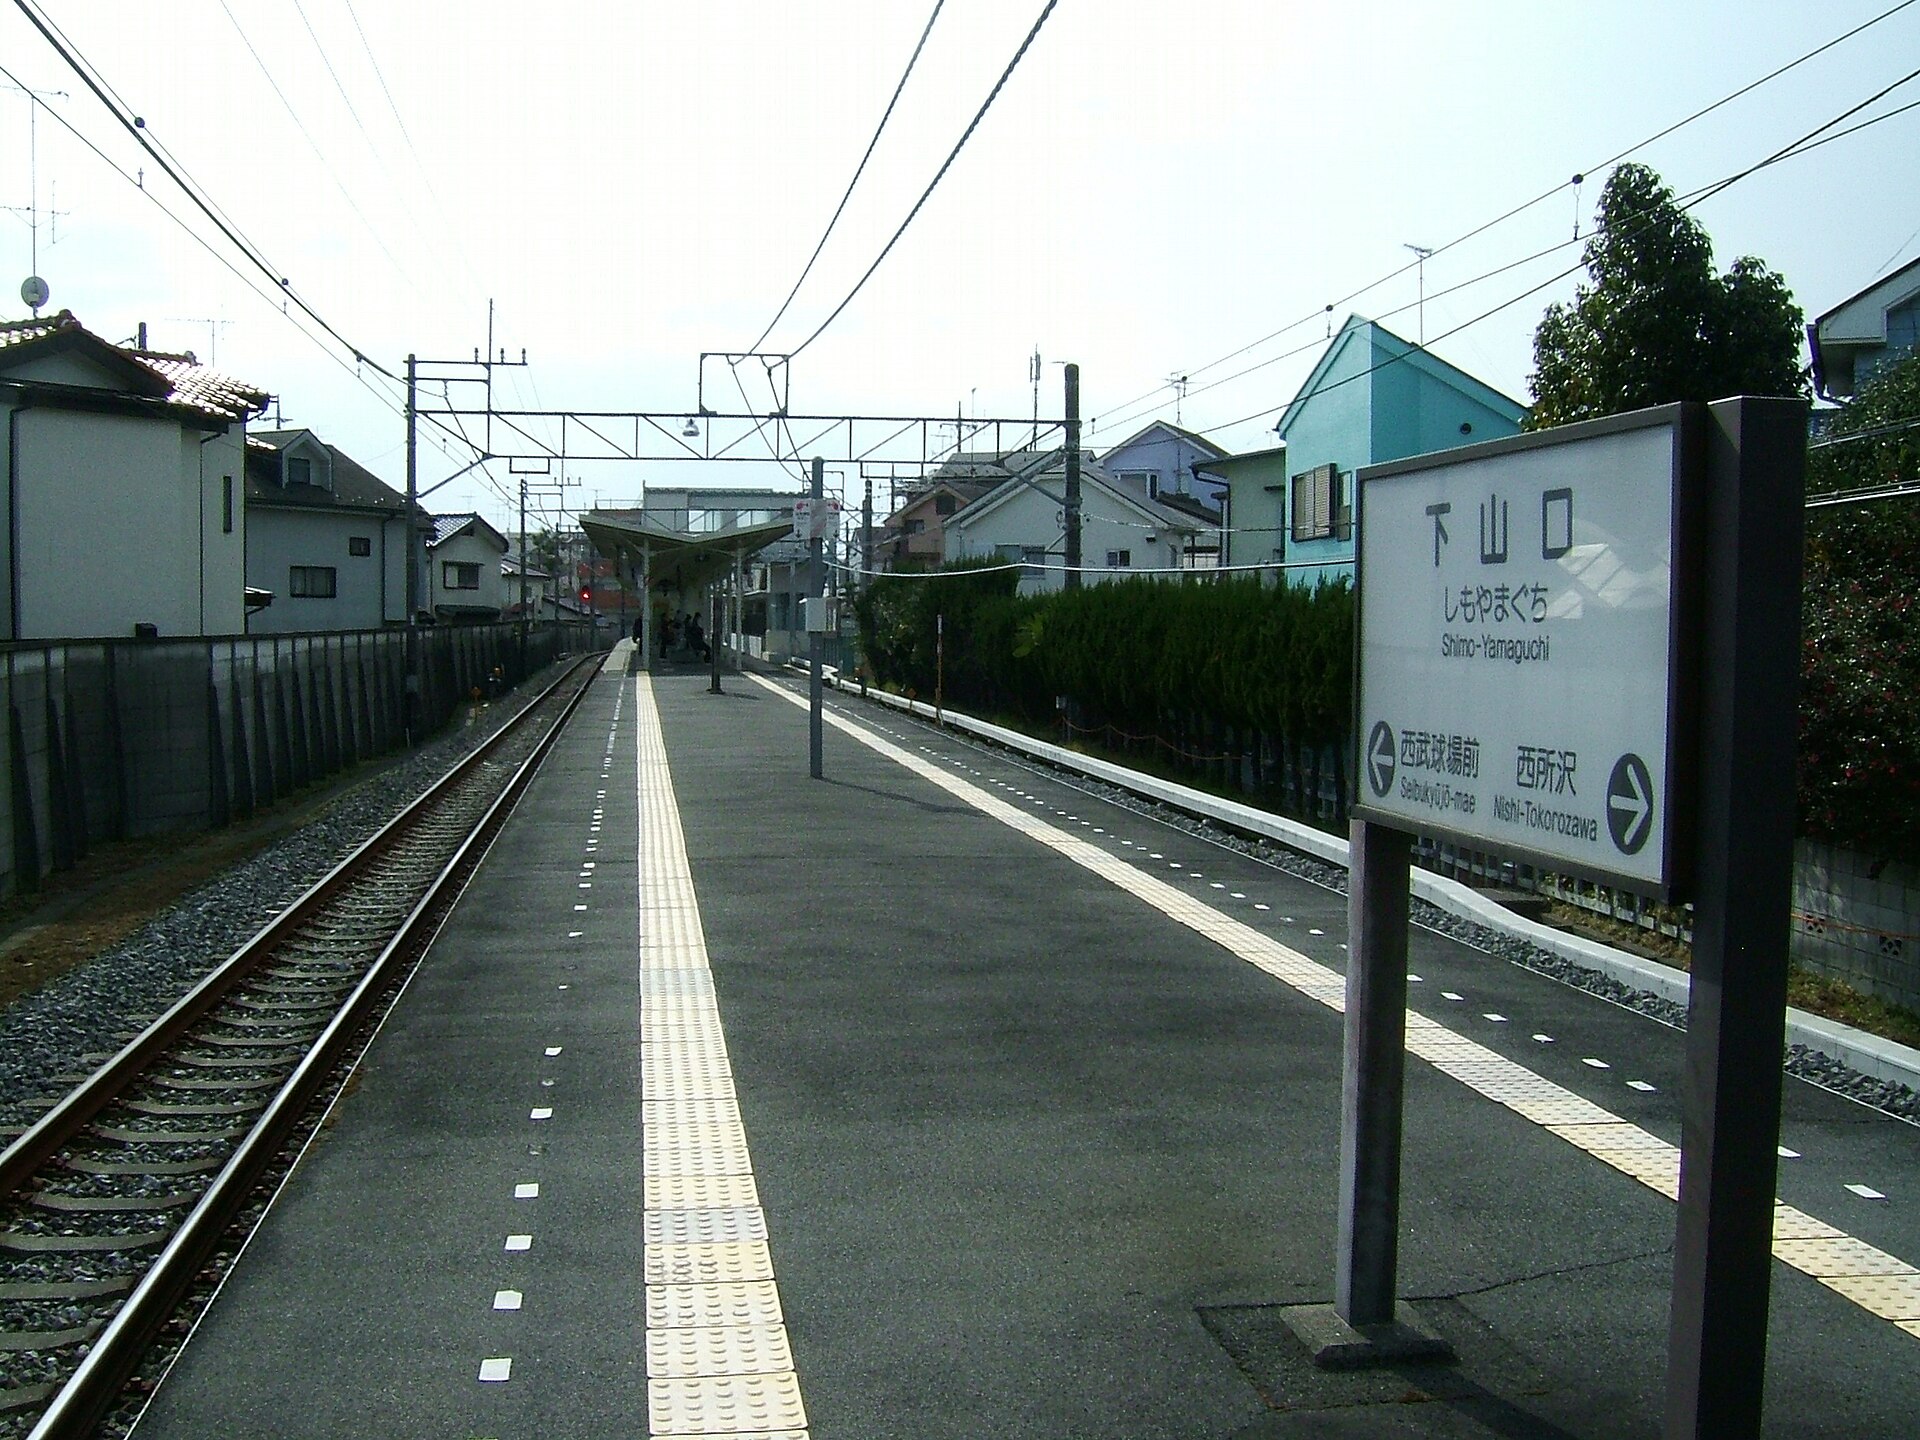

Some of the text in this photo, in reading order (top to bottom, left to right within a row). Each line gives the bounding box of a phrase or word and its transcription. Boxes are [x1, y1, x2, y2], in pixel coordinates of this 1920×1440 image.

[1426, 487, 1573, 567] 下山口
[1445, 582, 1548, 623] しもやまぐち
[1441, 632, 1550, 664] Shimo-Yamaguchi
[1400, 729, 1480, 779] 西武球場前
[1516, 744, 1577, 796] 西所沢
[1493, 794, 1597, 842] Nishi-Tokorozawa
